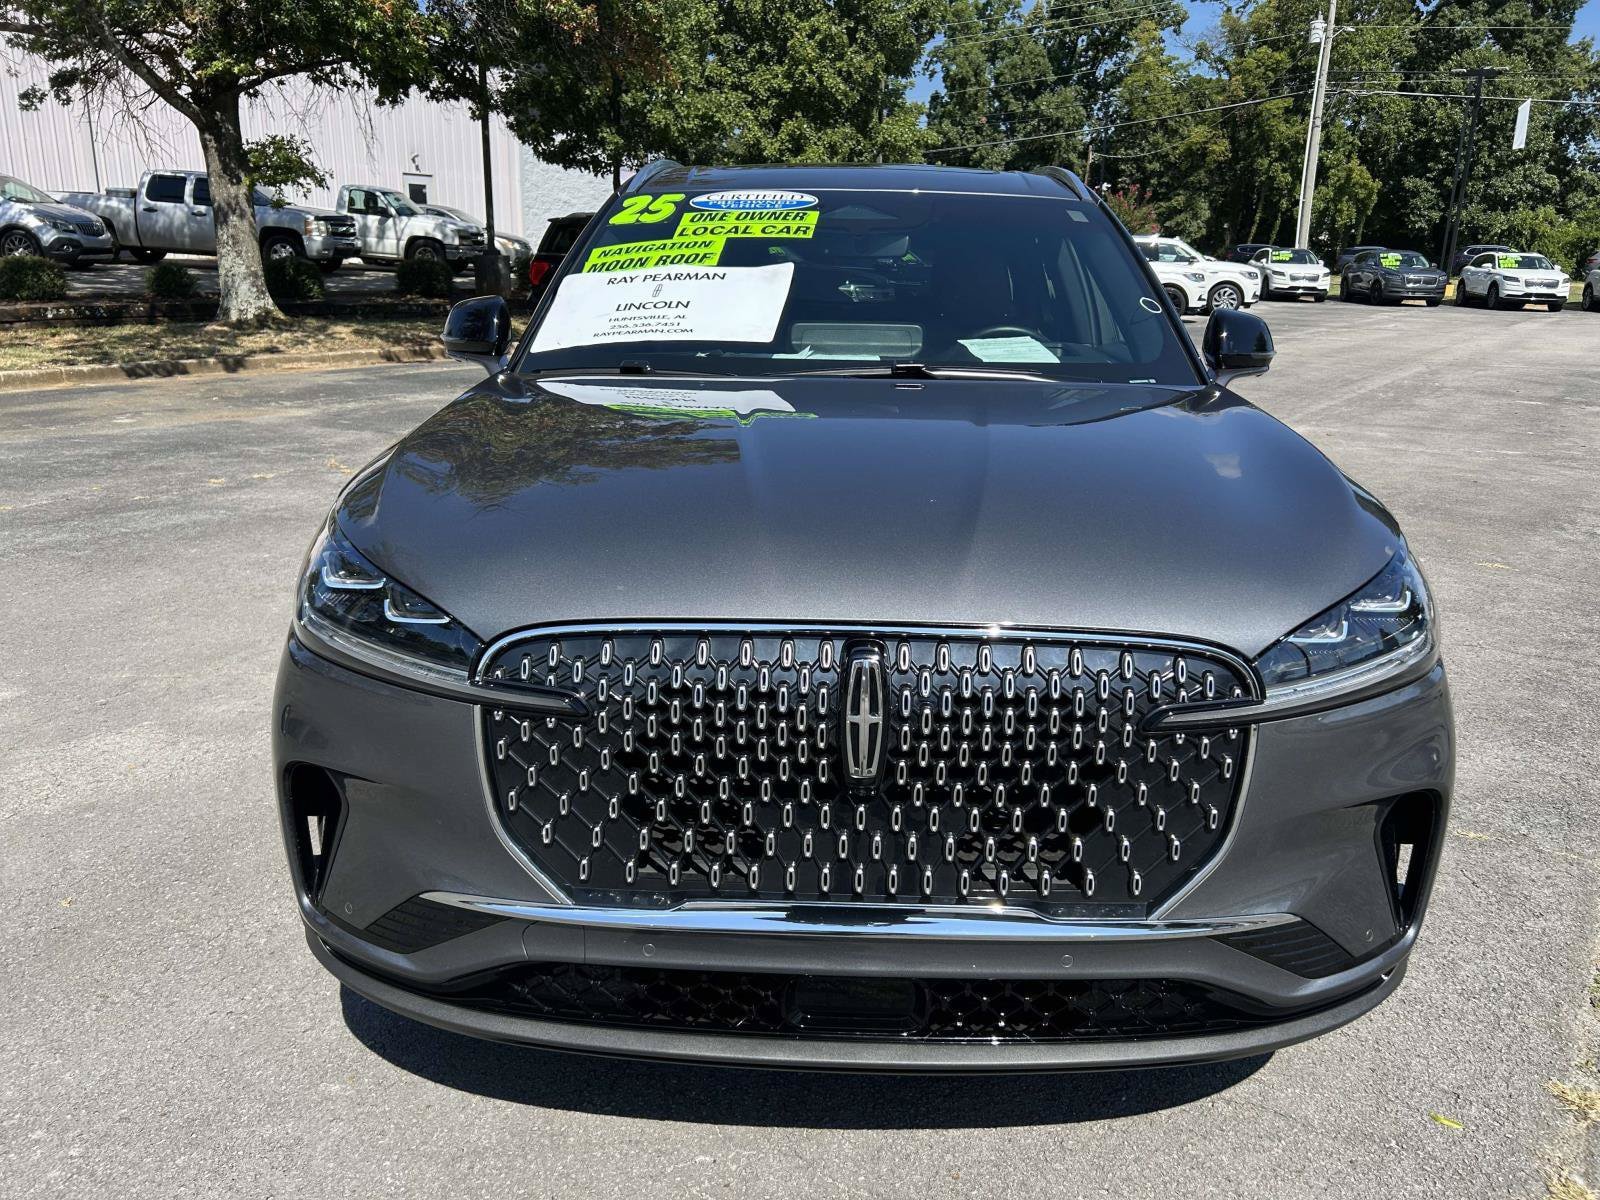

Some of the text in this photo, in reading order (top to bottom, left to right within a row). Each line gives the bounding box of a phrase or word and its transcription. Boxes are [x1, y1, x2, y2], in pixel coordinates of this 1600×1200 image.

[706, 193, 805, 201] CERTIFIED
[609, 193, 686, 225] 25
[689, 211, 809, 223] ONE OWNER
[677, 224, 812, 237] LOCAL CAR
[597, 240, 715, 259] NAVIGATION
[586, 252, 716, 274] MOON ROOF
[607, 272, 727, 286] RAY PEARMAN
[615, 300, 691, 312] LINCOLN
[608, 314, 671, 323] HUNTSVILLE,
[592, 328, 694, 338] RAYPEARMAN.COM
